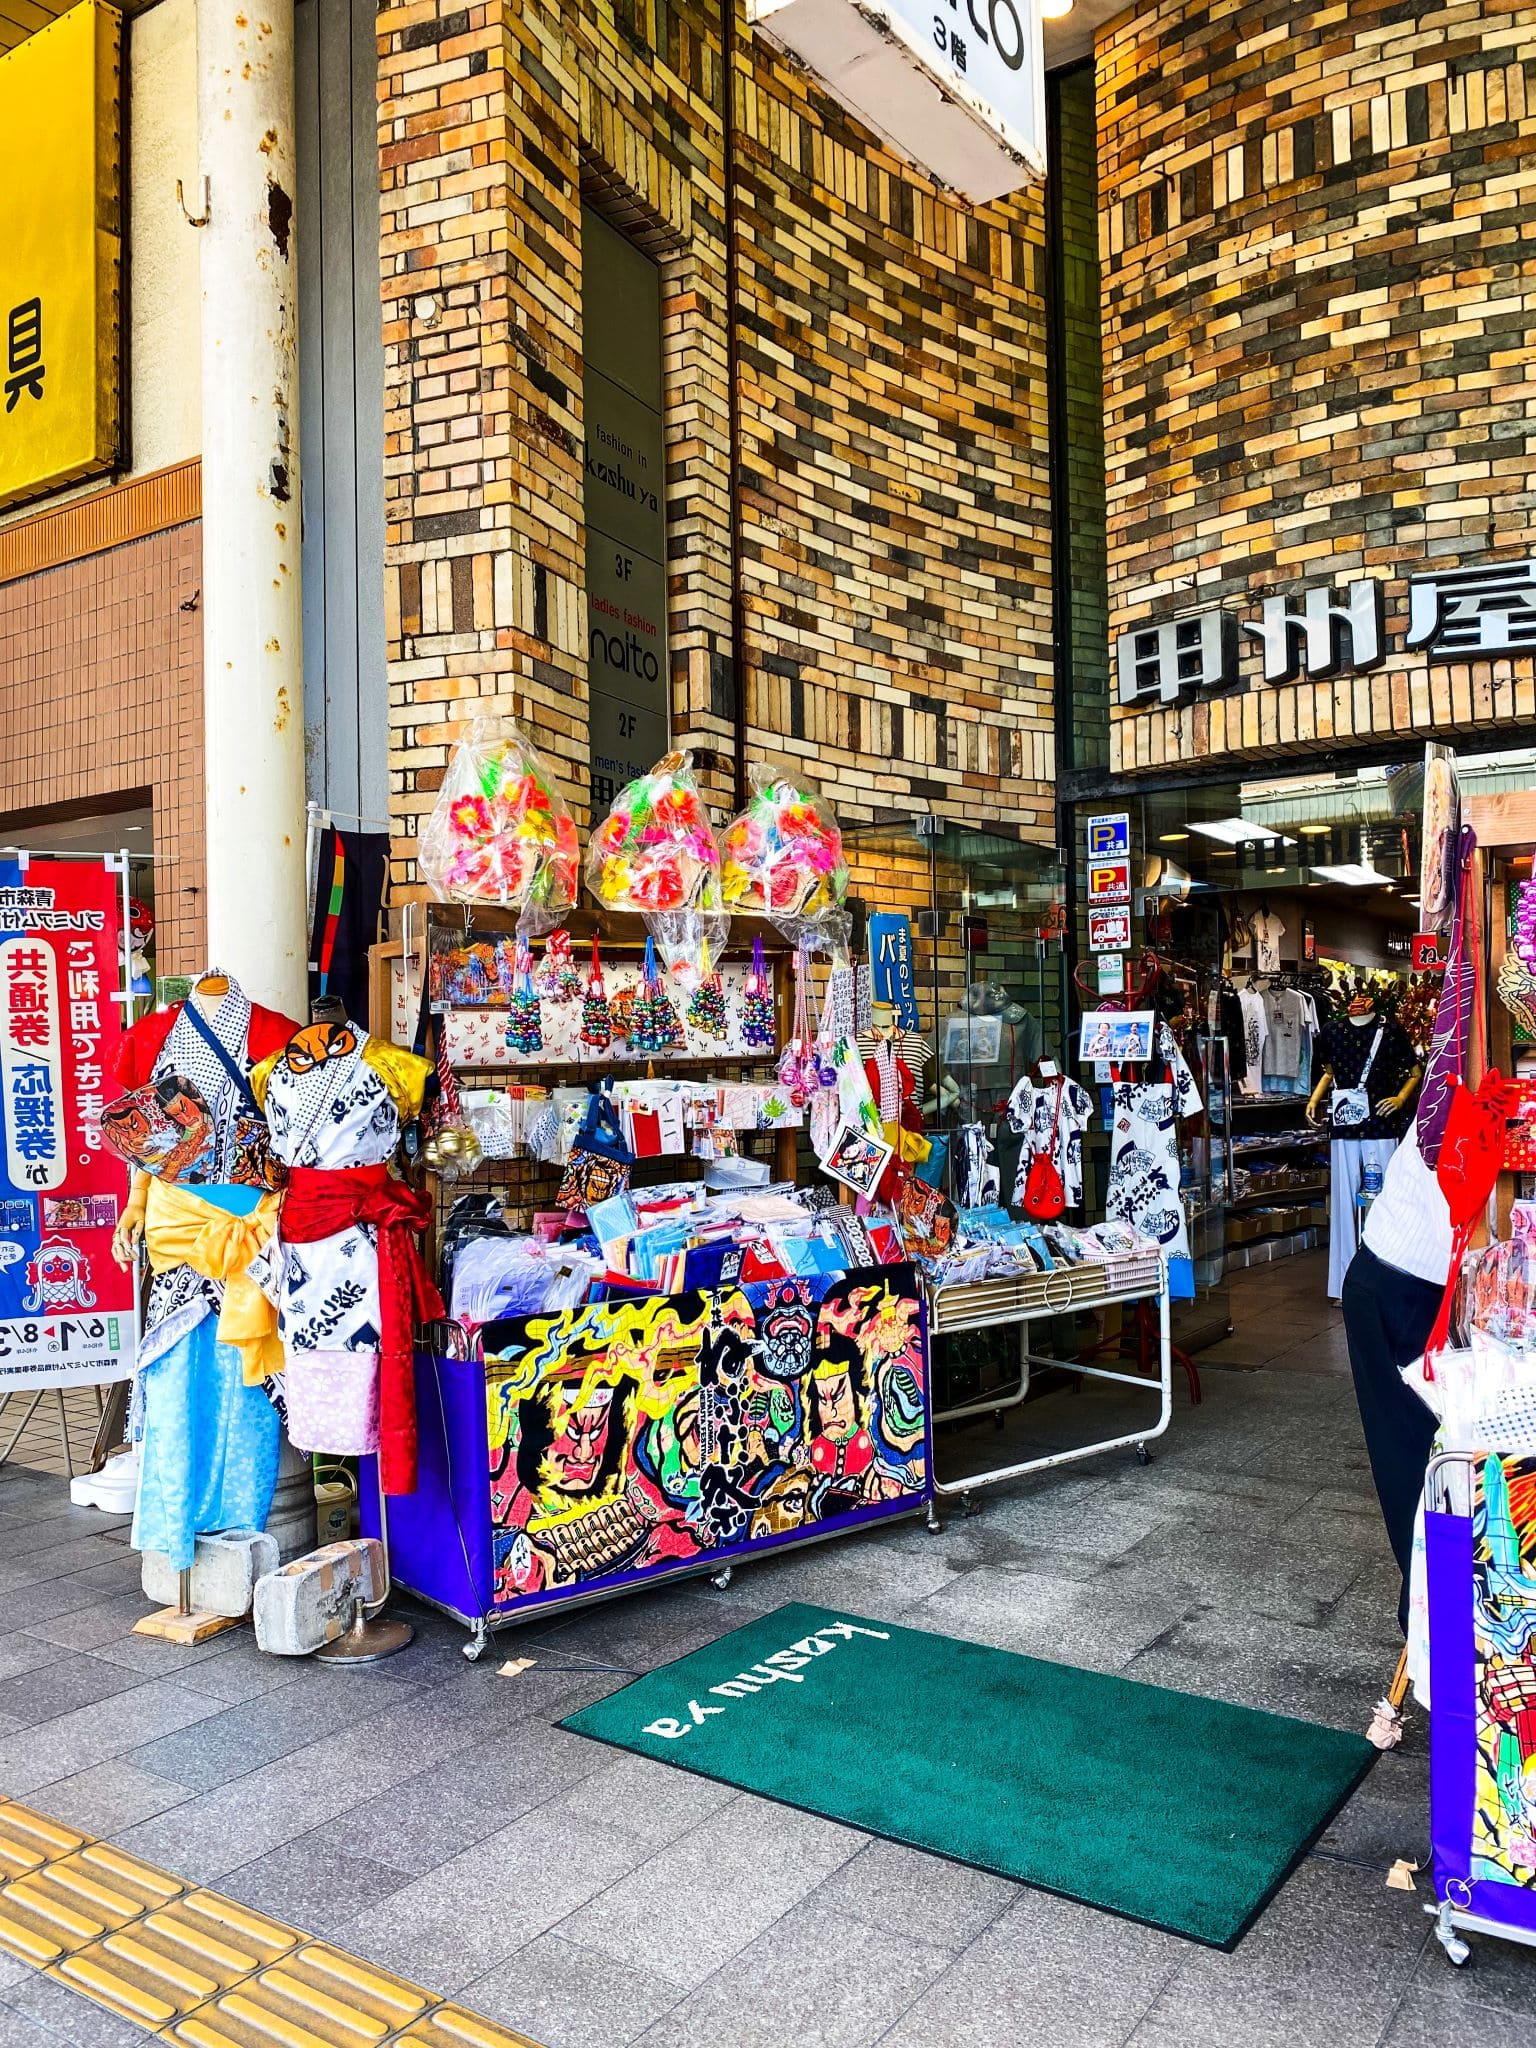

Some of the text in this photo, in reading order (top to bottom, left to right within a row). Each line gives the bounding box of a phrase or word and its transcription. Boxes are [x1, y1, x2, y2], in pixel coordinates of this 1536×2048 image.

[933, 15, 967, 73] 3階
[596, 424, 648, 469] fashion in
[639, 486, 659, 514] ya
[615, 553, 633, 582] 3F
[590, 592, 657, 637] ladies fashion
[1116, 558, 1536, 707] 甲州屋
[590, 627, 659, 683] naito
[618, 712, 637, 739] 2F
[594, 754, 624, 775] men's
[1093, 826, 1124, 852] P 共通
[1093, 869, 1125, 893] P 共通
[699, 1389, 708, 1468] NEBUTA FESTIVAL
[706, 1388, 714, 1454] JAPAN AOMORI
[641, 1698, 726, 1739] ya
